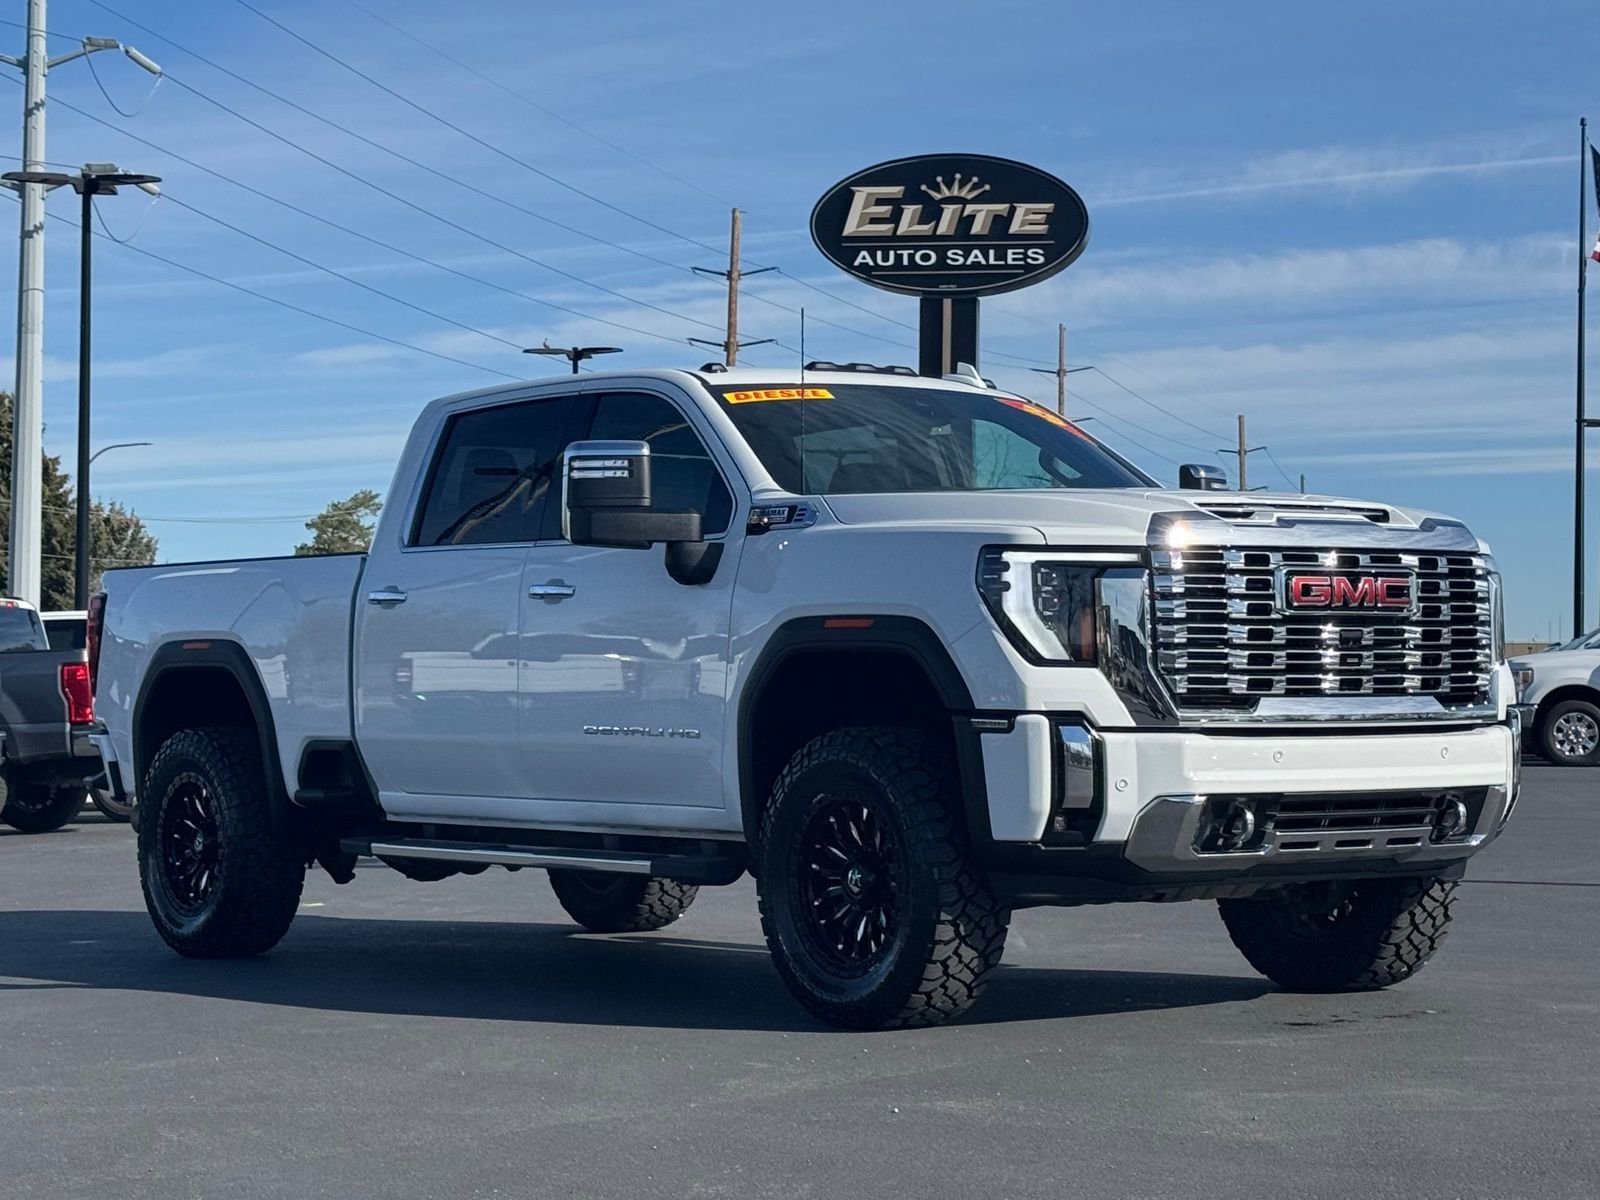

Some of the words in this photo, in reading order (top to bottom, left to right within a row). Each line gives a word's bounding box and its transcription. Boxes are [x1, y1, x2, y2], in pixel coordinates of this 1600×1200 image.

[842, 186, 1055, 236] ELITE
[853, 250, 937, 266] AUTO
[946, 248, 1045, 265] SALES
[734, 390, 826, 401] DIESEL
[1291, 576, 1412, 607] GMC
[583, 725, 664, 737] DENALI
[667, 728, 700, 739] HD
